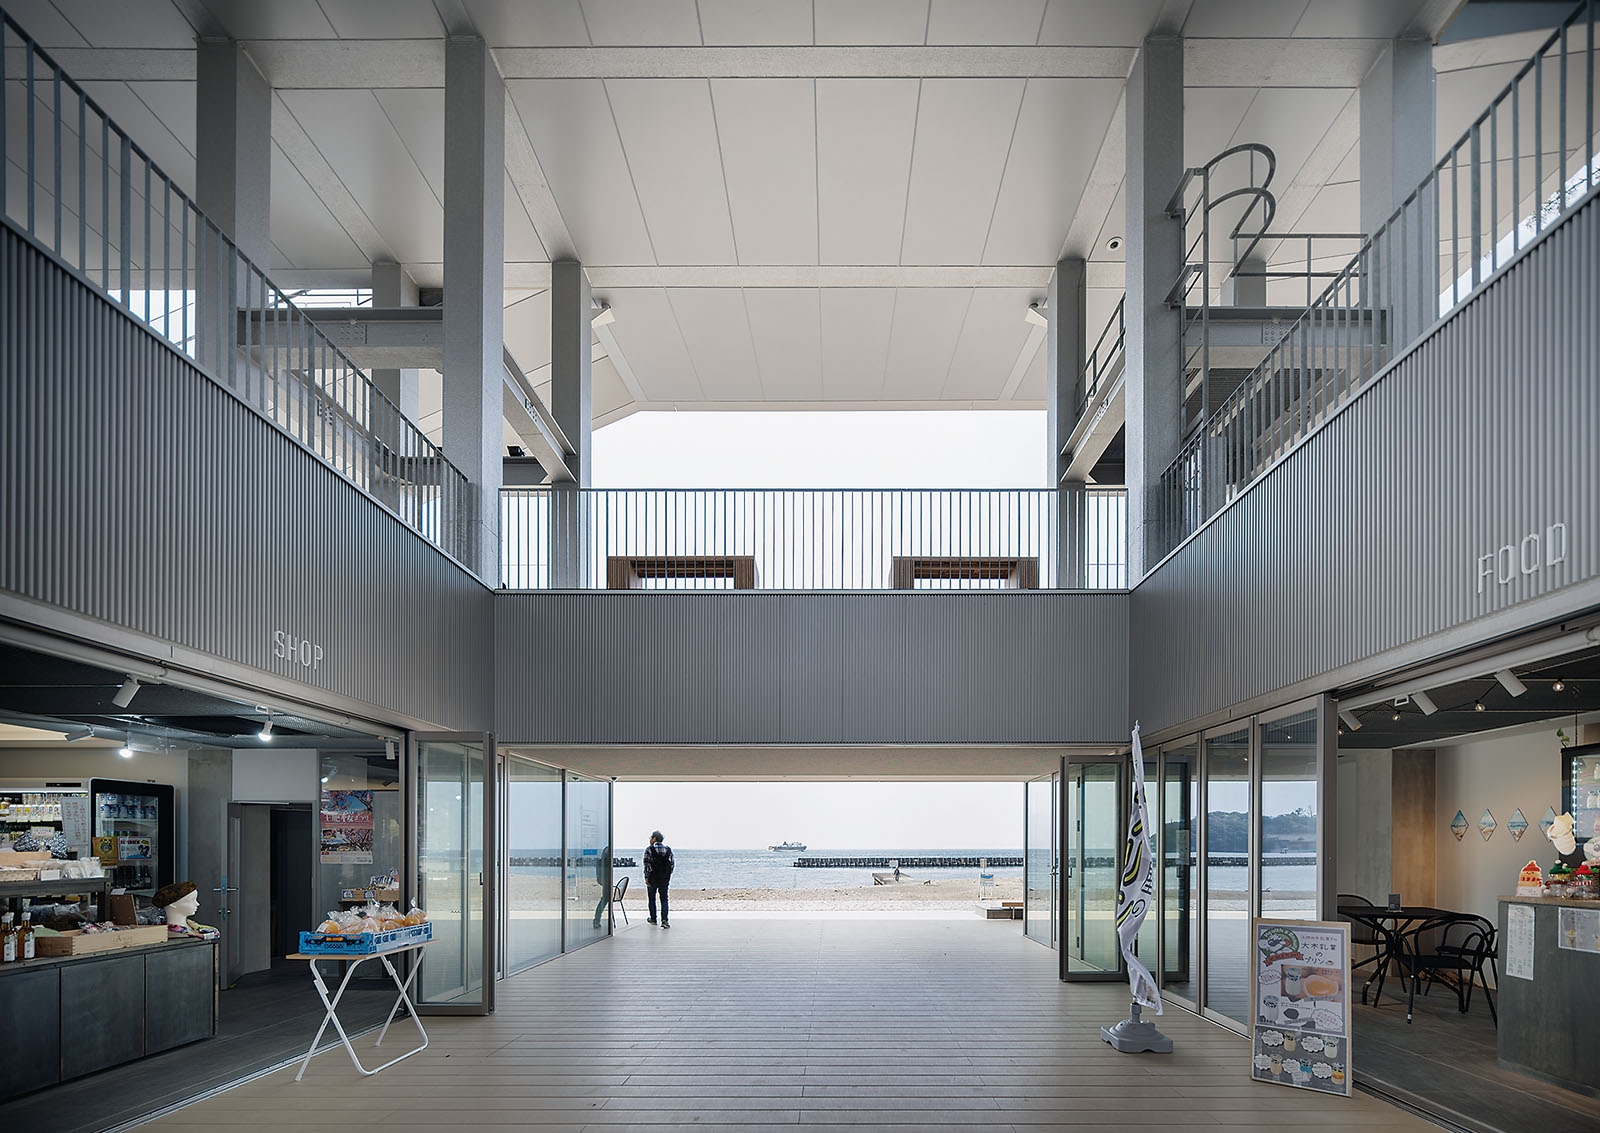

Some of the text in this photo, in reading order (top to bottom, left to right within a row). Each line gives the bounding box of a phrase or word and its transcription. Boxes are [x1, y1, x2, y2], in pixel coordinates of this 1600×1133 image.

[1478, 523, 1566, 594] FOOD
[274, 630, 324, 670] SHOP
[1304, 956, 1325, 965] プリン
